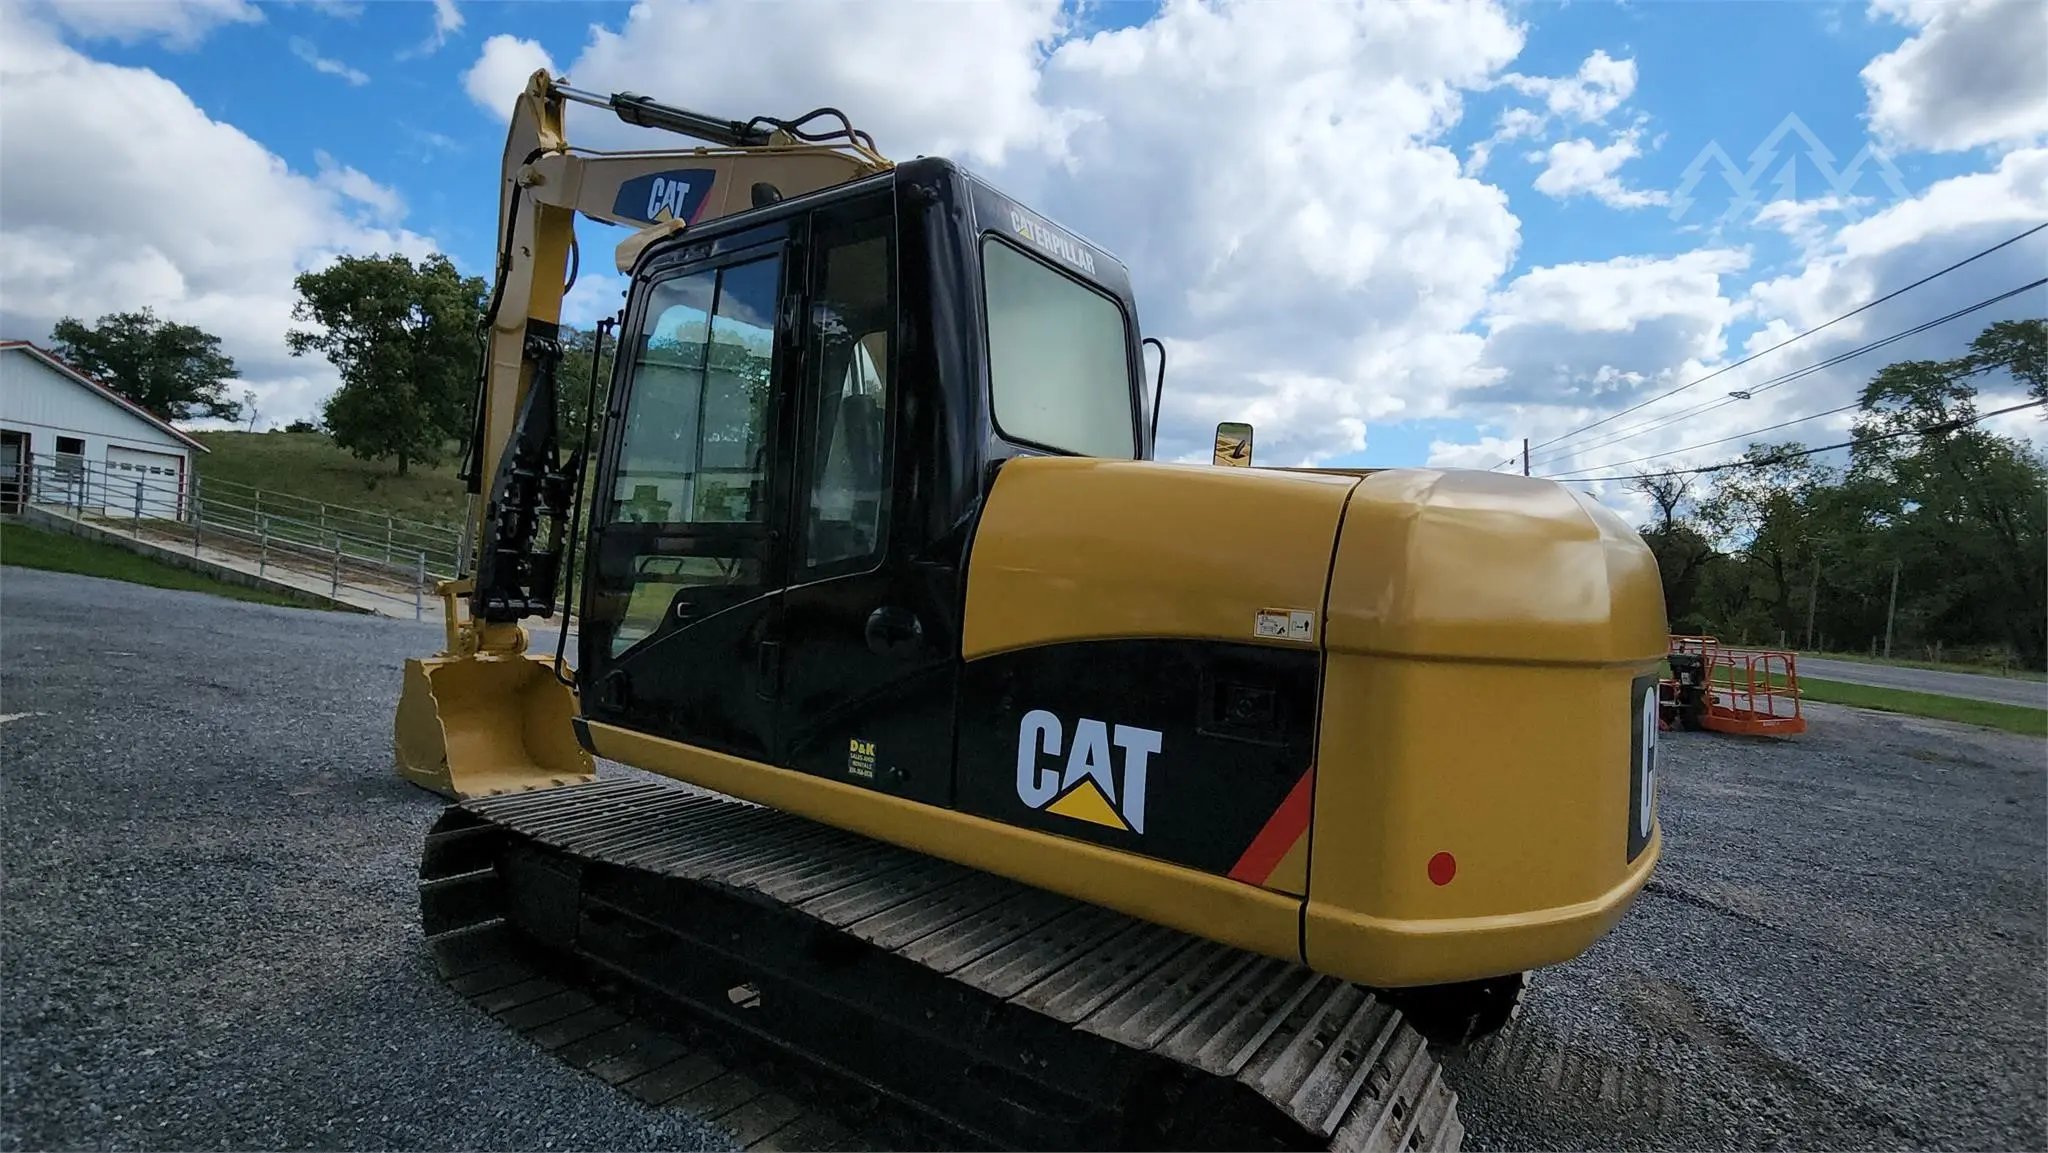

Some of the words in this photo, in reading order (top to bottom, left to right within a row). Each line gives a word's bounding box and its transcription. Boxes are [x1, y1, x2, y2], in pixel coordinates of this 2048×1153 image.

[646, 177, 690, 219] CAT
[1010, 210, 1096, 275] CATERPILLAR
[850, 739, 875, 756] D&K
[1016, 709, 1163, 835] CAT
